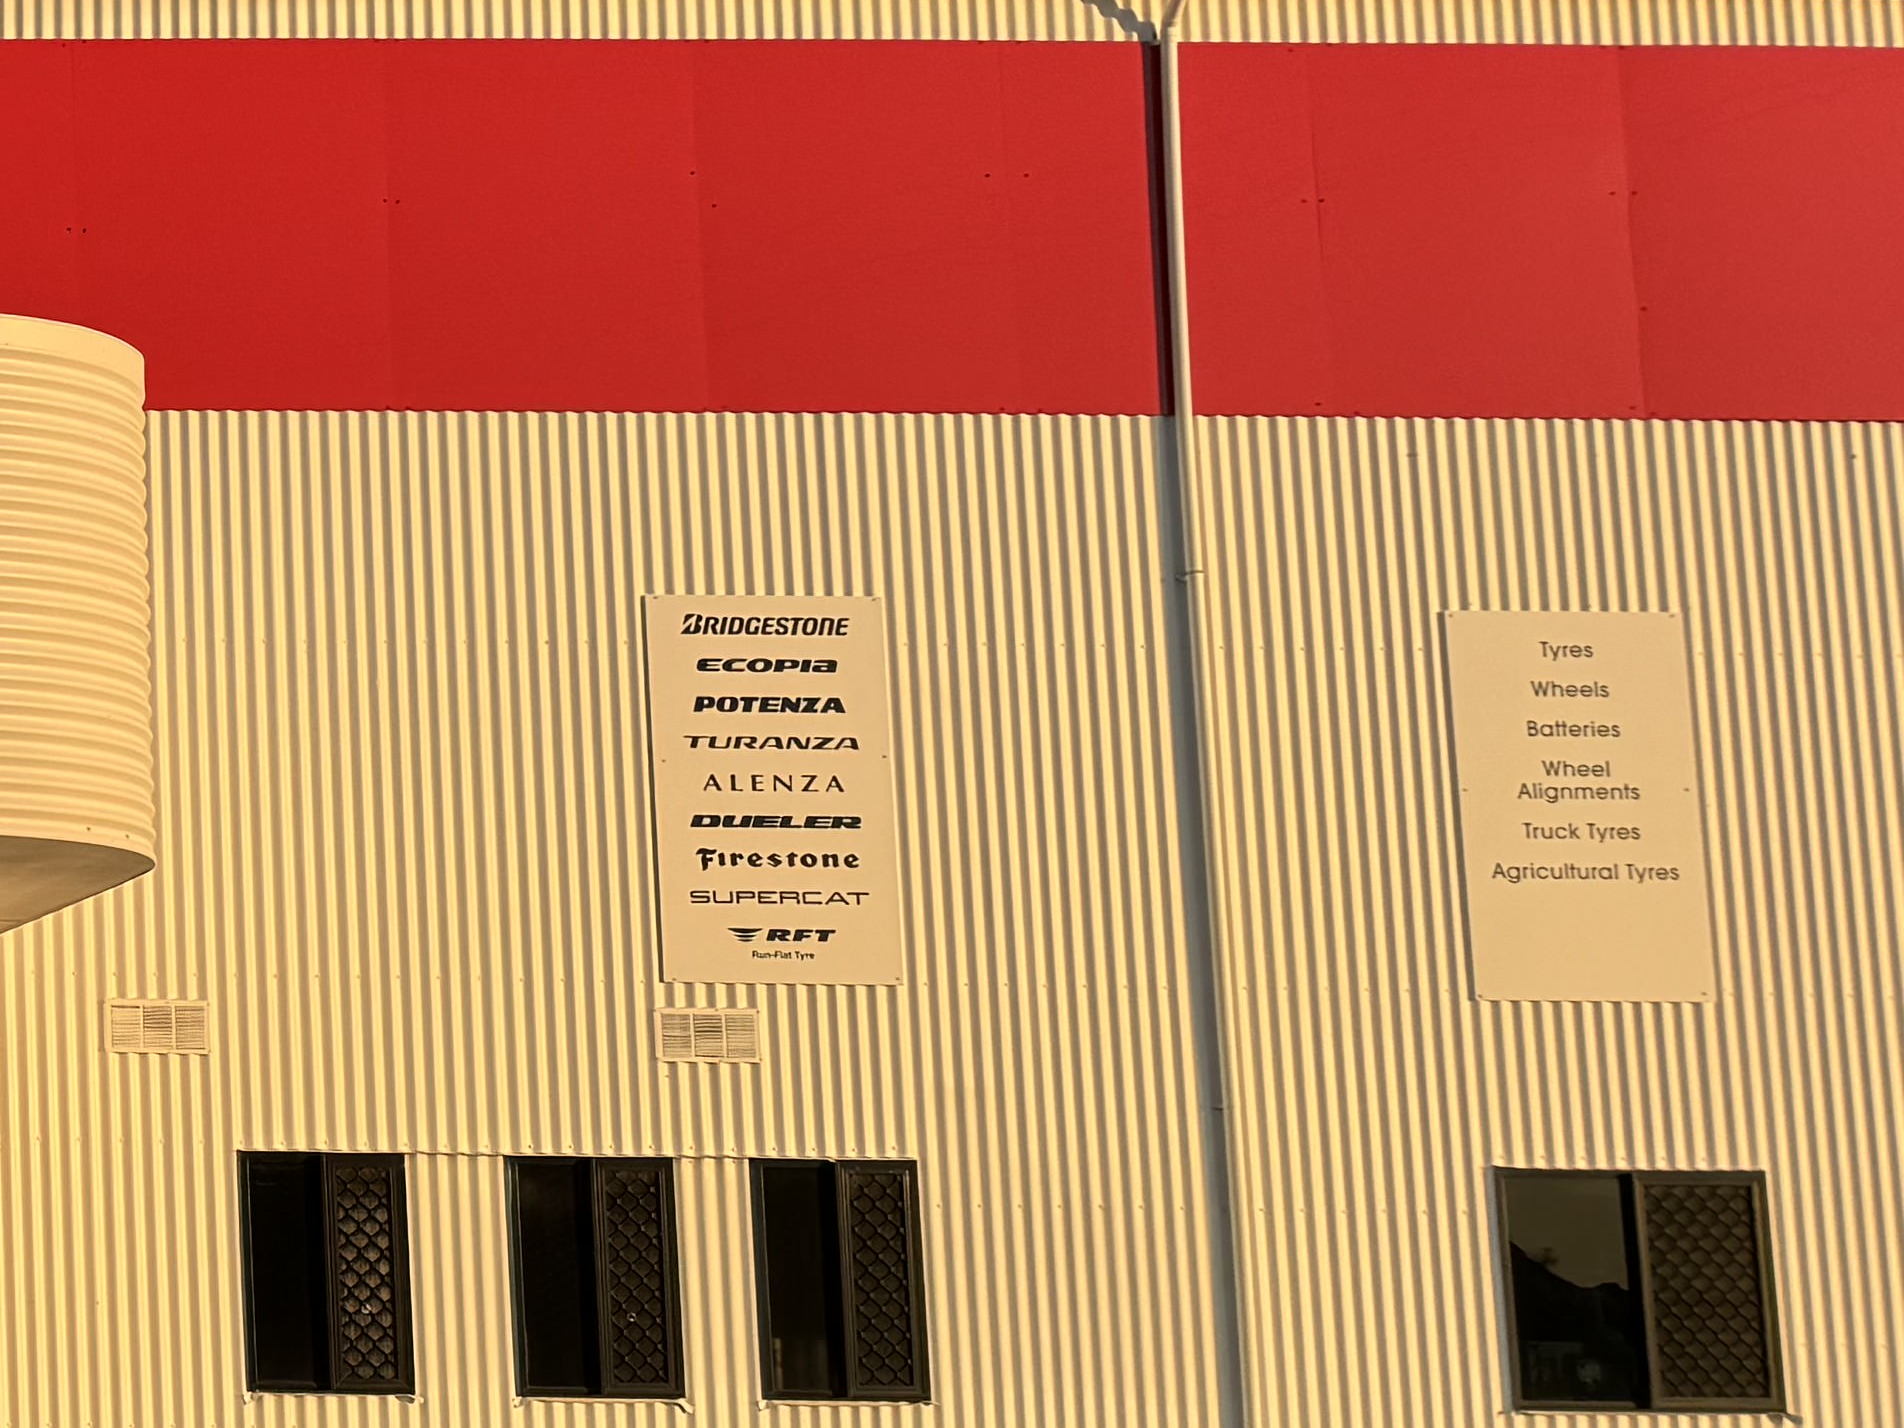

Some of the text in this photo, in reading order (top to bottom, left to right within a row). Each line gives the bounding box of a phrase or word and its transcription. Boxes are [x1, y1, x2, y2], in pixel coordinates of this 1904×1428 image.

[680, 613, 850, 636] BRIDGESTONE
[1538, 640, 1594, 662] Tyres
[1530, 680, 1610, 698] Wheels
[693, 696, 846, 714] POTENZA
[1526, 719, 1621, 738] Batteries
[683, 735, 860, 751] TURANZA
[1541, 760, 1611, 778] Wheel
[703, 773, 845, 793] ALENZA
[1517, 782, 1641, 804] Alignments
[690, 814, 862, 829] DUELER
[1522, 822, 1641, 844] Truck Tyres
[695, 847, 860, 872] Firestone
[1491, 862, 1680, 884] Agricultural Tyres
[689, 890, 870, 906] SUPERCAT
[766, 928, 837, 942] RFT
[794, 950, 815, 961] Tyre
